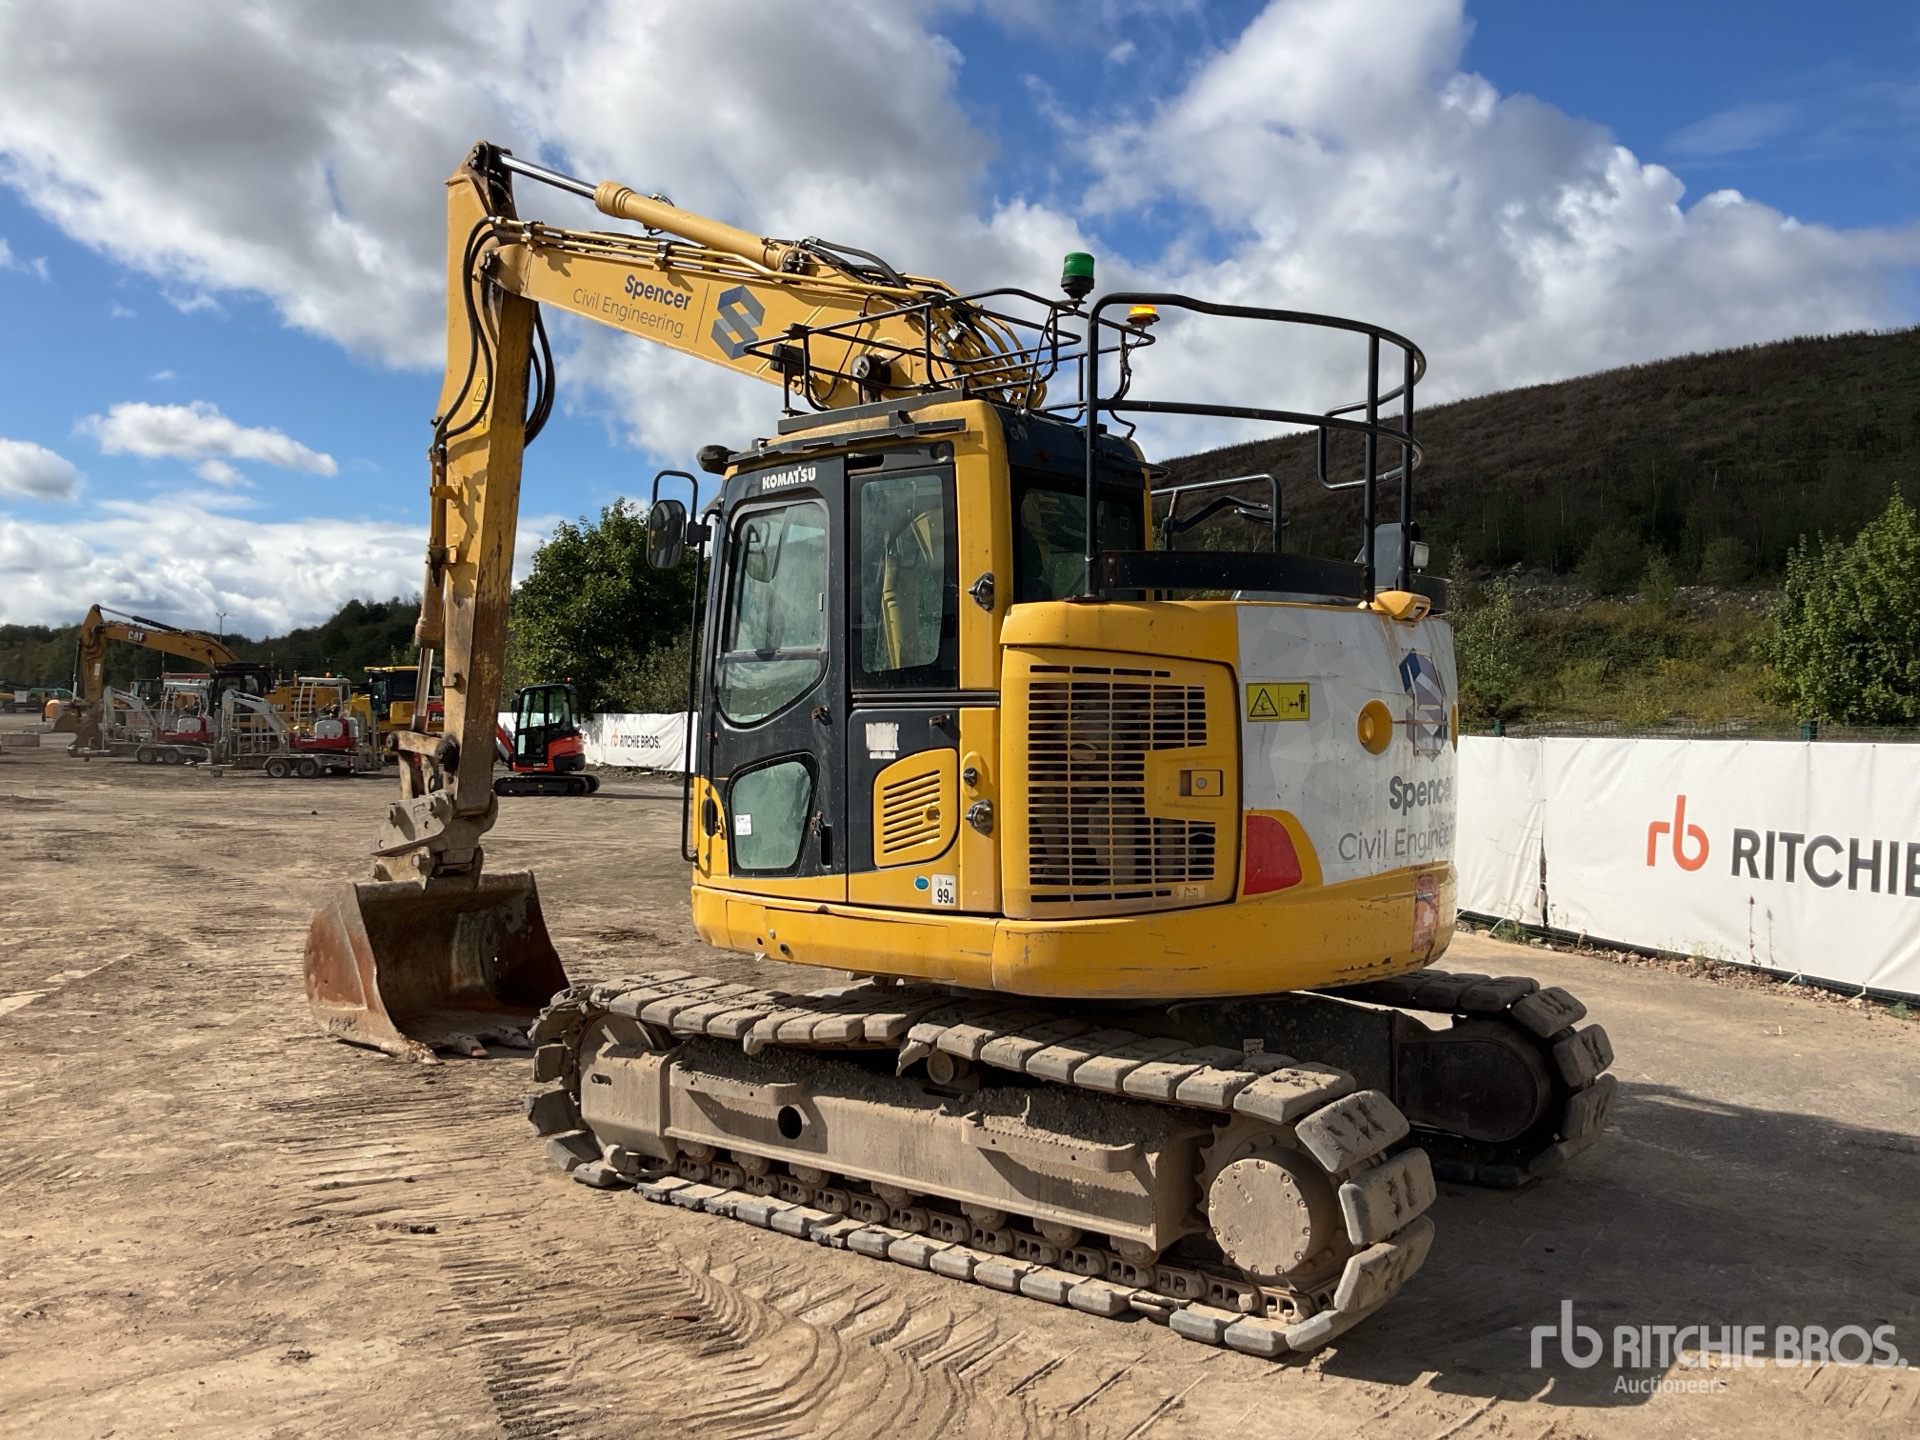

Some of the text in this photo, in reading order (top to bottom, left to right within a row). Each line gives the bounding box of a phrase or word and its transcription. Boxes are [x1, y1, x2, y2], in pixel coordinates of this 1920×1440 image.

[625, 274, 691, 310] Spencer
[573, 288, 684, 338] Civil Engineering
[762, 466, 816, 490] KOMATSU
[128, 630, 144, 641] CAT
[620, 735, 640, 748] RITCHIE
[1338, 828, 1388, 861] Civil
